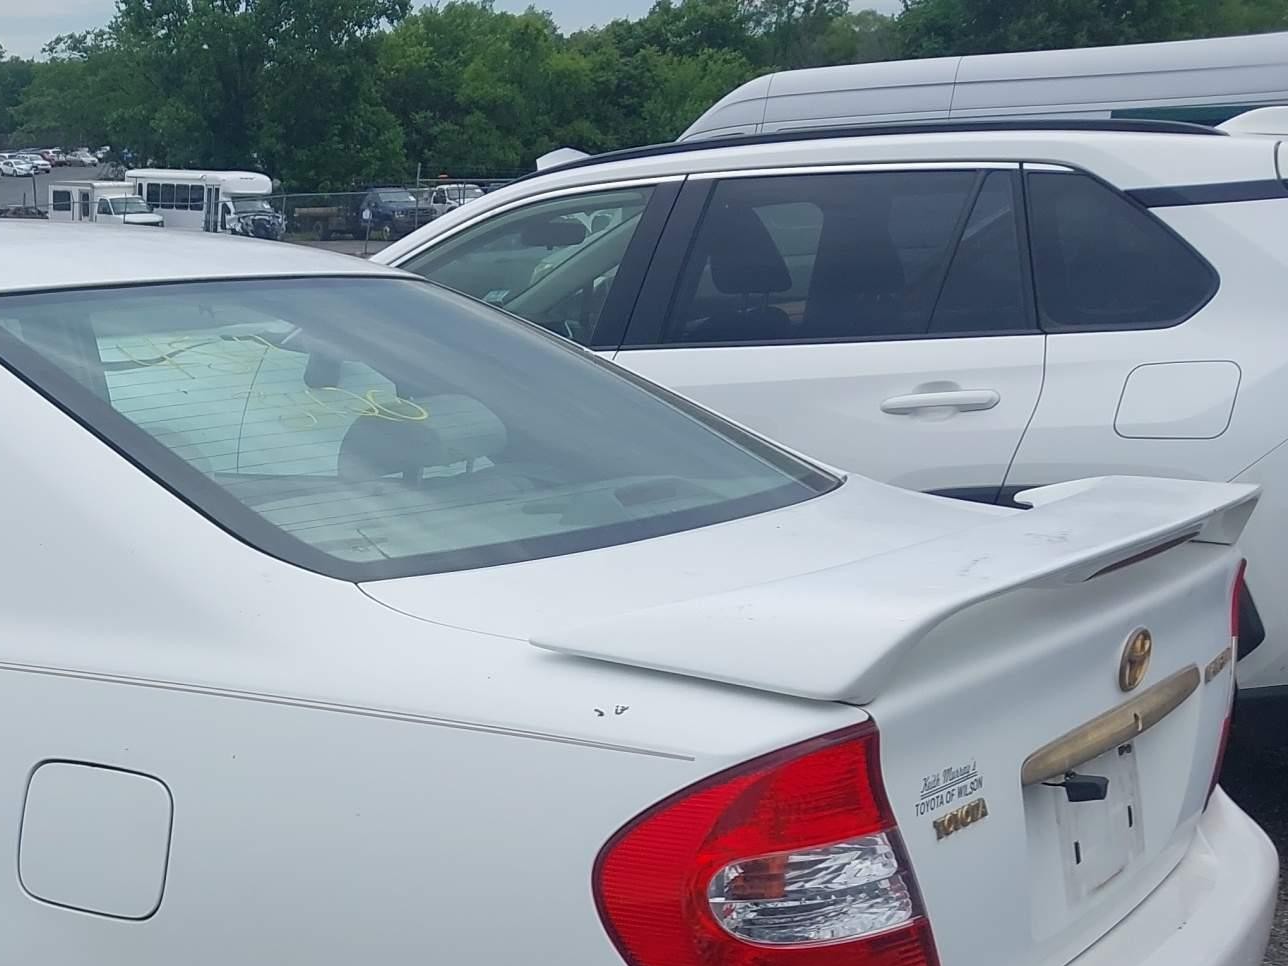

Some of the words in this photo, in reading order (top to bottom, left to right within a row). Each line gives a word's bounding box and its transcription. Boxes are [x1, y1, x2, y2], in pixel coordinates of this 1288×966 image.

[915, 794, 944, 817] TOYOTA
[945, 788, 956, 804] OF
[957, 776, 984, 799] WILSON
[933, 797, 989, 841] TOYOTA
